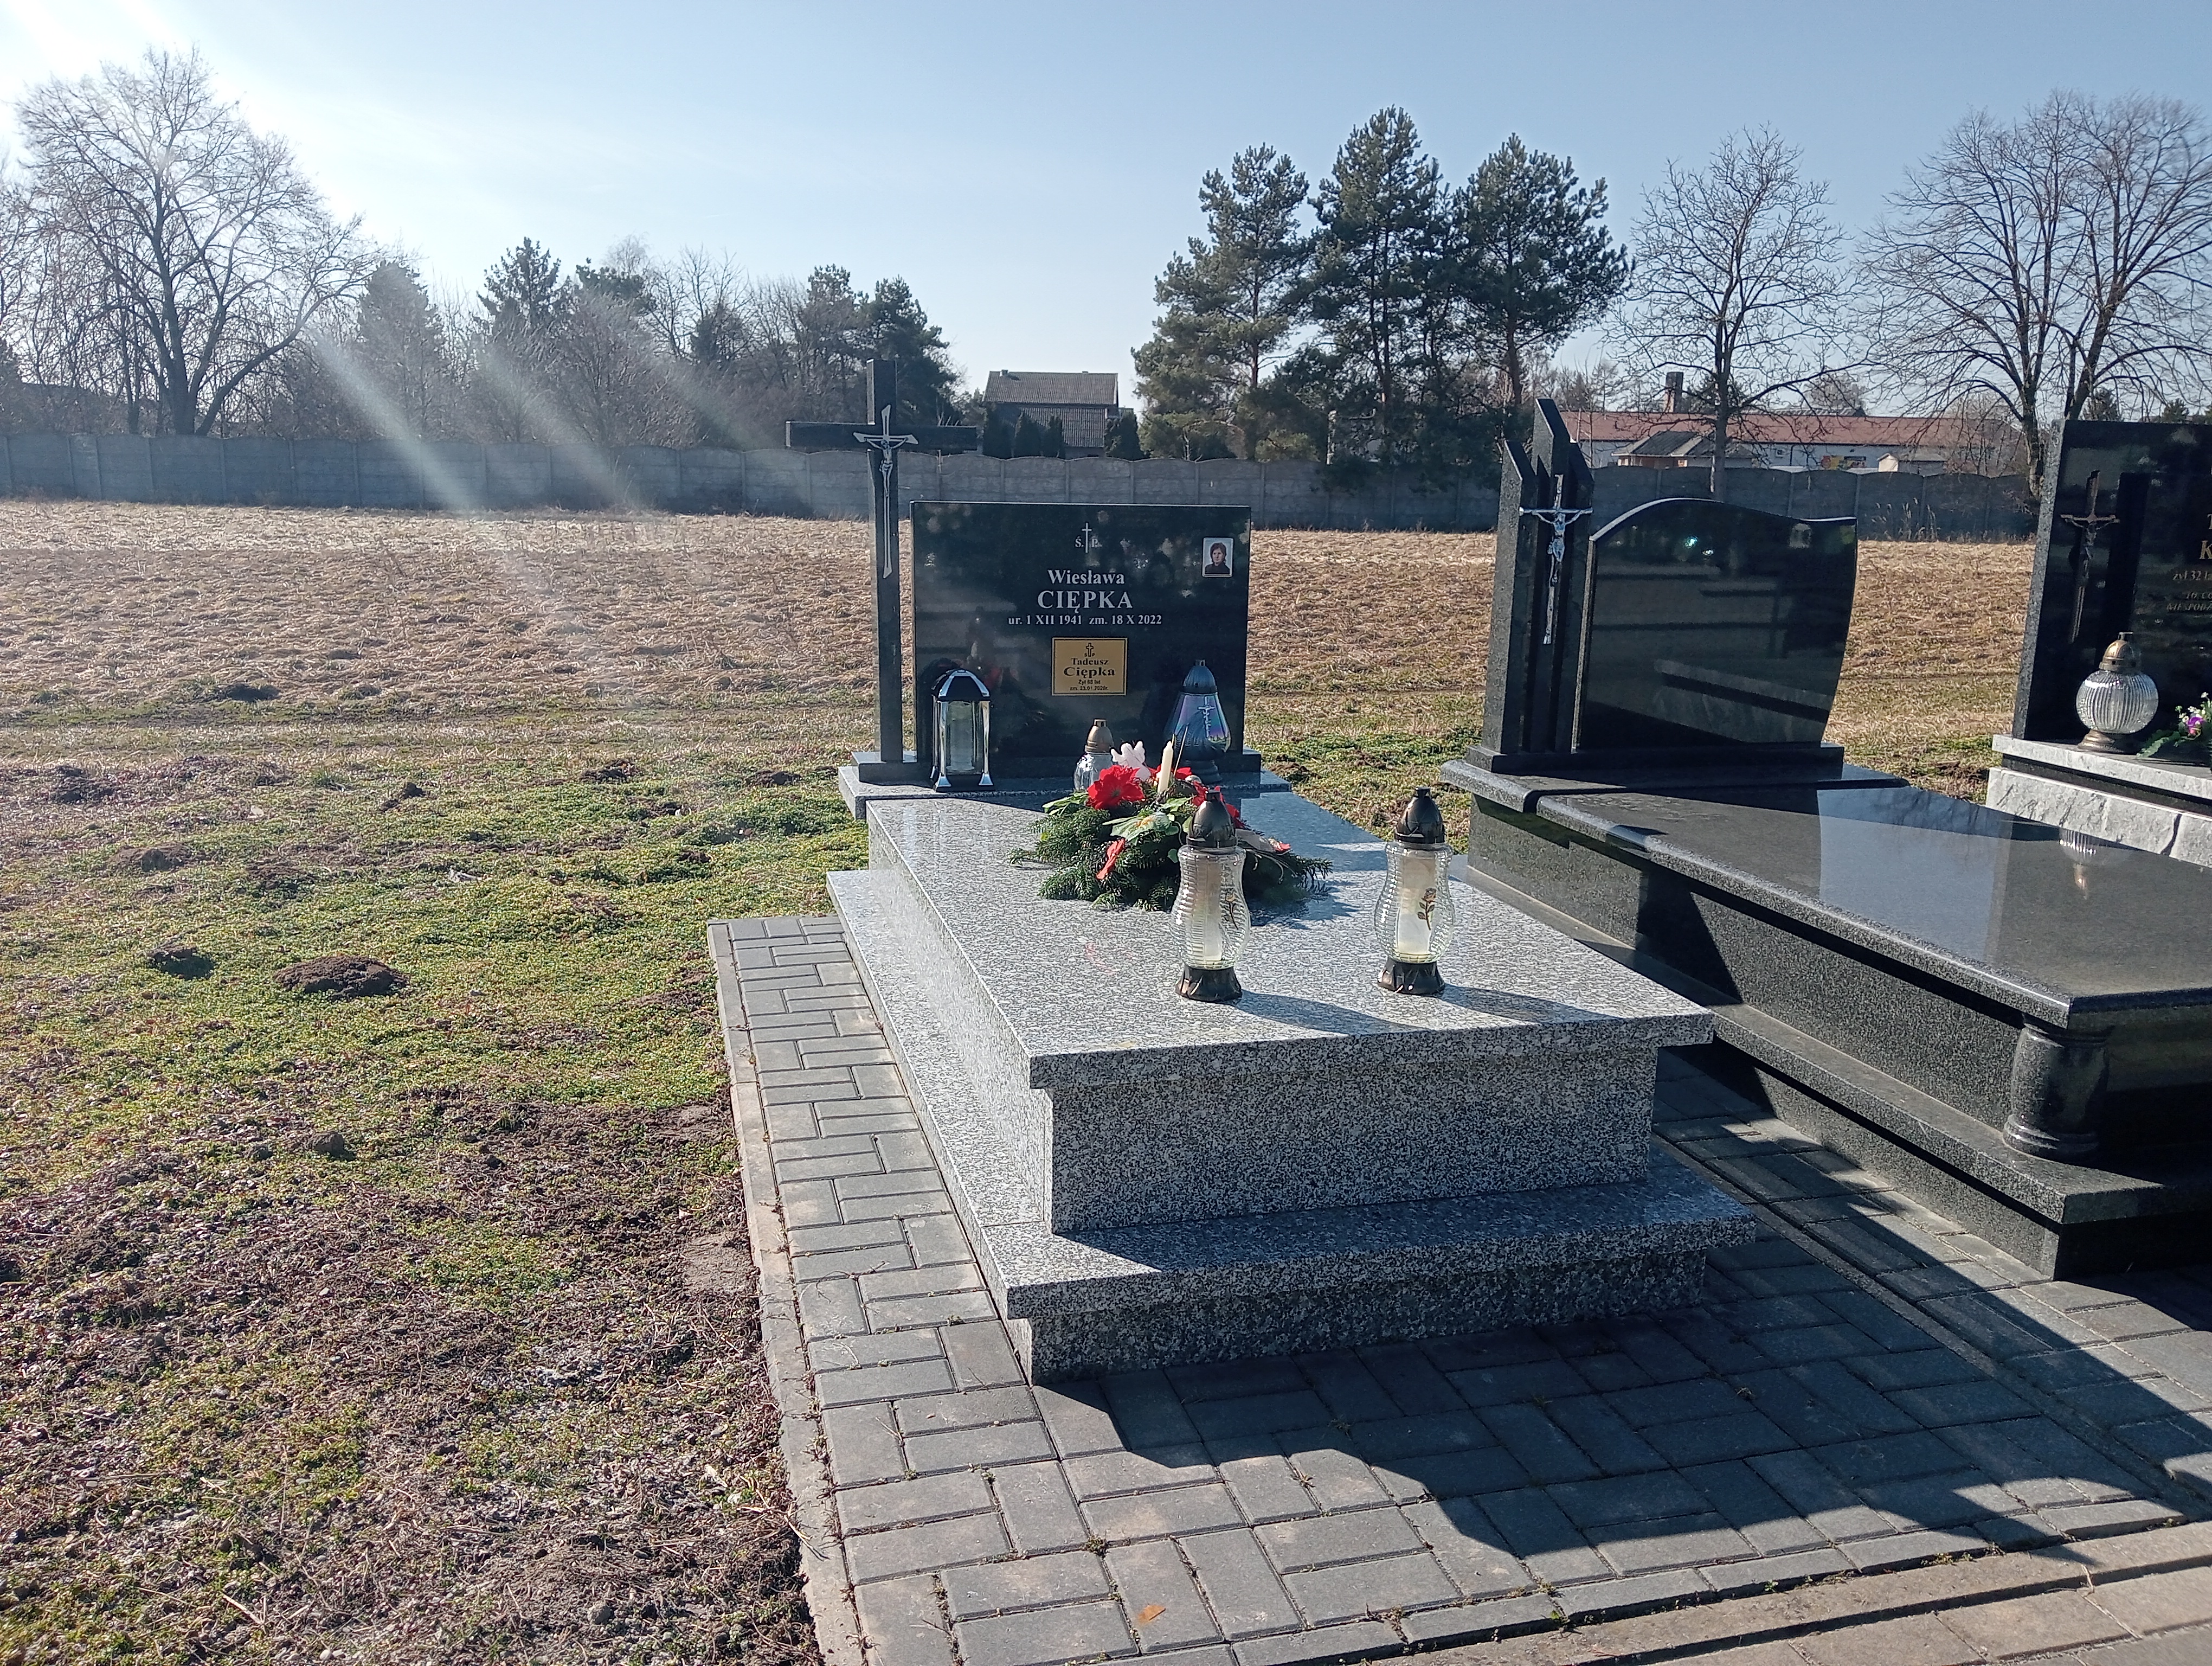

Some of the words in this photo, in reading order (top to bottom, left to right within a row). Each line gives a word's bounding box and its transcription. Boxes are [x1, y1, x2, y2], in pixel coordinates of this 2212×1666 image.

[1047, 569, 1125, 584] Wiesława
[1037, 590, 1133, 613] CIĘPKA
[1027, 615, 1031, 624] 1
[1036, 615, 1054, 624] XII
[1059, 615, 1082, 624] 1941
[1112, 615, 1123, 624] 18
[1126, 615, 1134, 624] X
[1138, 615, 1162, 624] 2022
[1064, 667, 1115, 678] Ciępka
